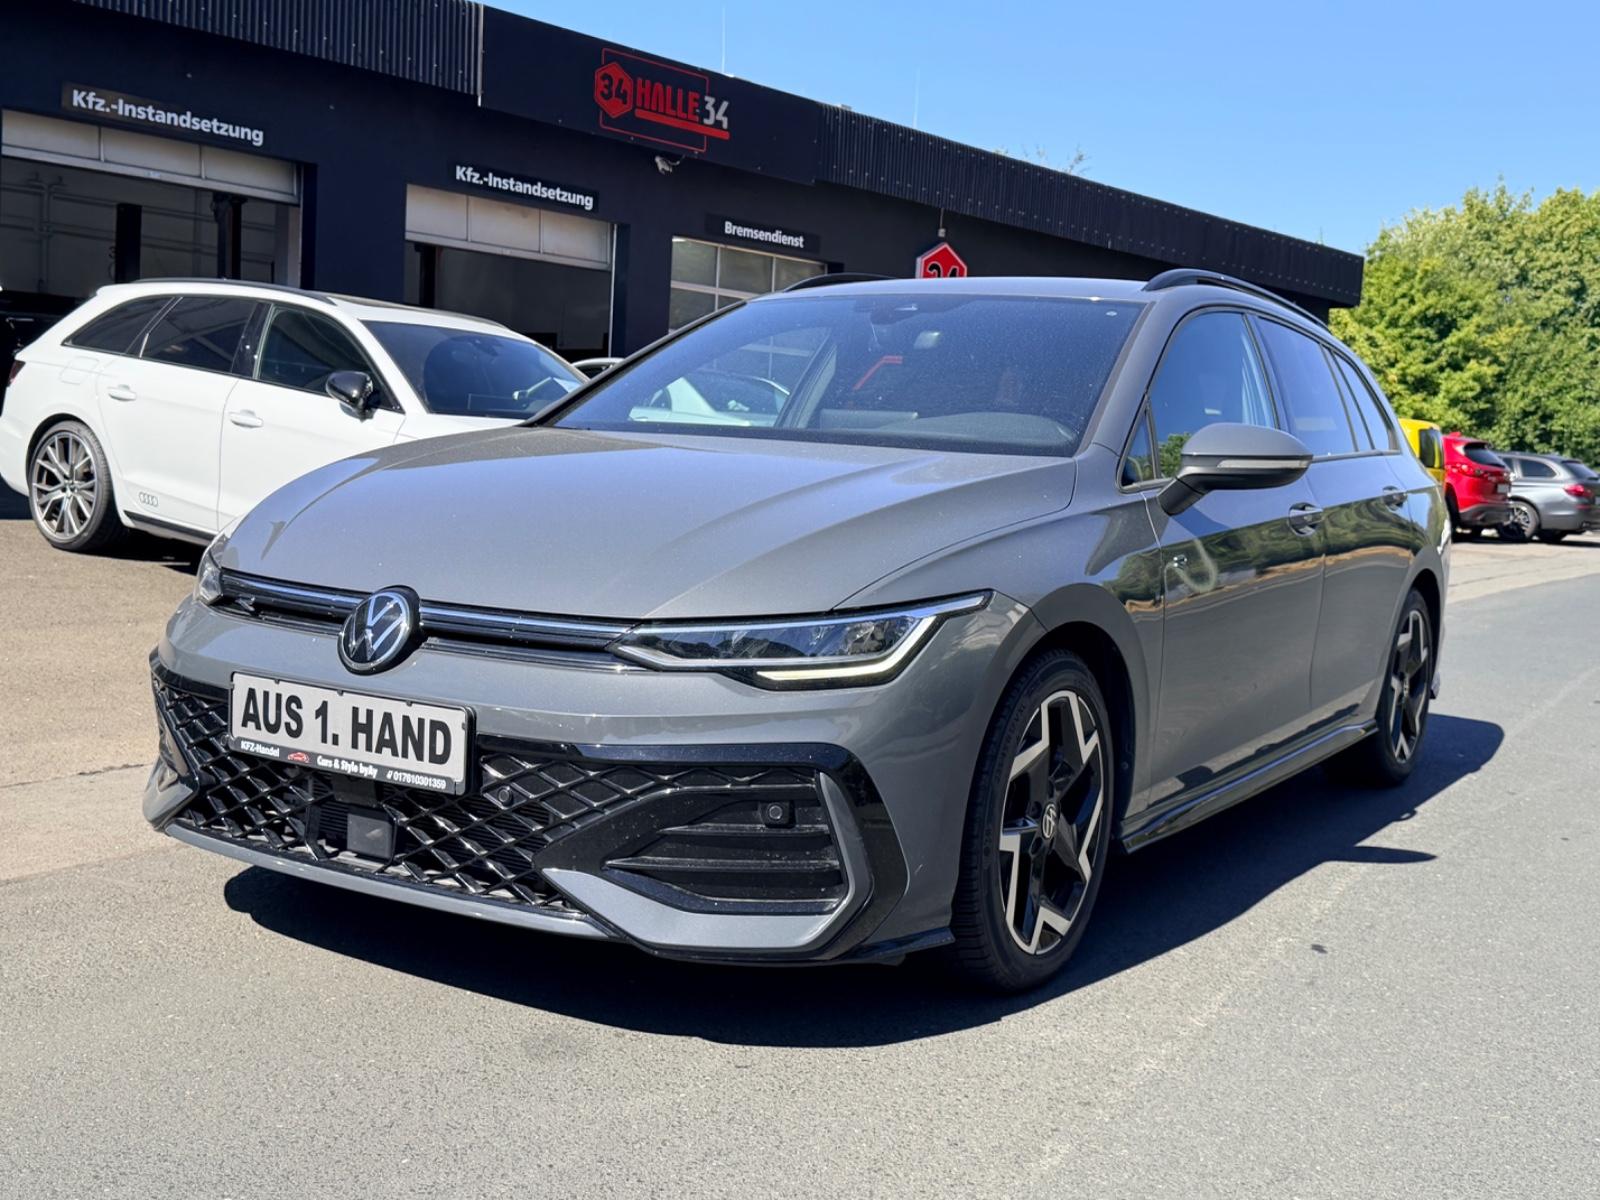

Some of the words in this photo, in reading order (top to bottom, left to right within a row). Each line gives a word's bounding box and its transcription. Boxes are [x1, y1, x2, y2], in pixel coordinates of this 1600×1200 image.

[600, 73, 628, 105] 34
[72, 89, 264, 146] Kfz.-Instandsetzung
[455, 165, 594, 210] Kfz.-Instandsetzung
[724, 221, 804, 248] Bremsendienst
[241, 687, 303, 738] AUS
[315, 700, 339, 746] 1.
[351, 706, 451, 765] HAND
[241, 740, 280, 758] KFZ-Handel
[317, 755, 333, 768] Cars
[333, 758, 340, 769] &
[341, 760, 358, 774] Style
